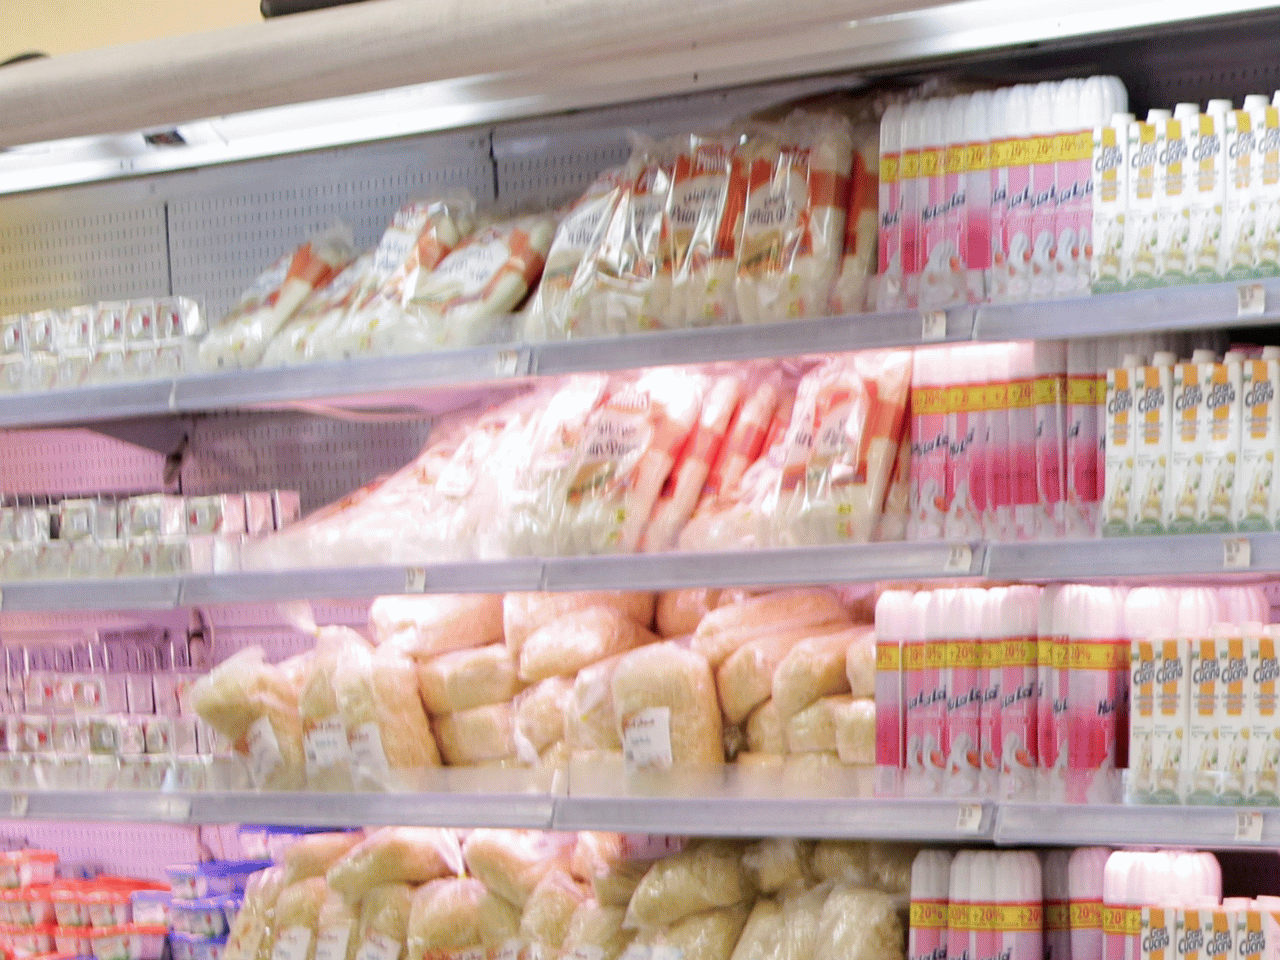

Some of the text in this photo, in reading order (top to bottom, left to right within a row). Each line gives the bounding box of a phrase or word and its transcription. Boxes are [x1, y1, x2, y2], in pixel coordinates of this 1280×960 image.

[1151, 927, 1167, 938] Gran
[1186, 929, 1202, 939] Gran
[1215, 931, 1230, 941] Gran
[1248, 931, 1264, 941] Gran
